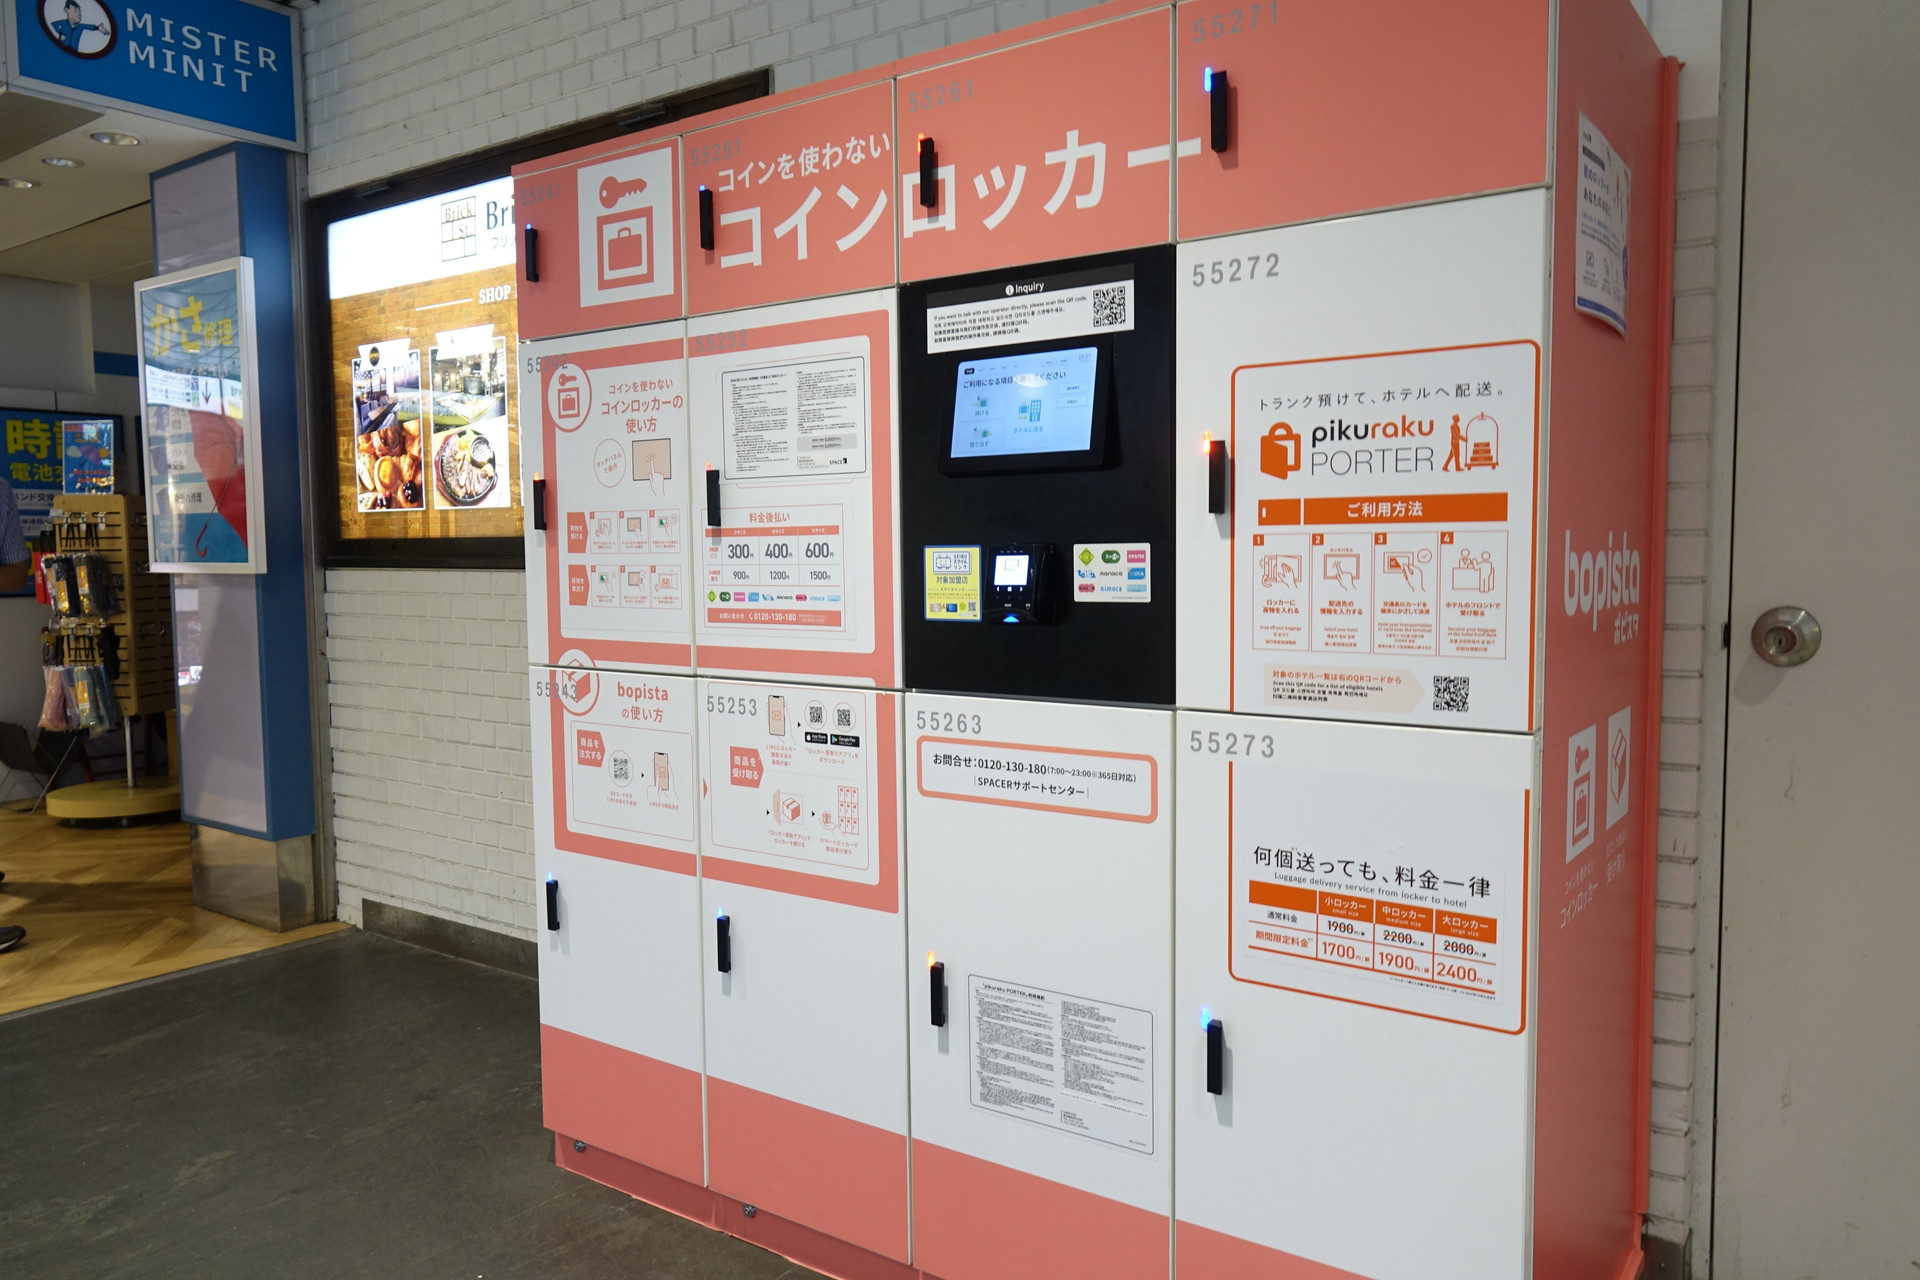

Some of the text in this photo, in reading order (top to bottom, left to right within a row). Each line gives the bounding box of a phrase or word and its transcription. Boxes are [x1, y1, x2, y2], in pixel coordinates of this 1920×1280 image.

[1192, 2, 1279, 43] 55271
[126, 8, 278, 73] MISTER
[129, 41, 253, 93] MINIT
[908, 78, 973, 113] 55261
[691, 138, 743, 168] 55251
[719, 132, 891, 193] コインを使わない
[520, 182, 562, 206] 55241
[720, 129, 1201, 269] コインロッカー
[1193, 253, 1279, 287] 55272
[479, 284, 507, 304] SHOP
[1015, 281, 1045, 296] Inquiry
[696, 329, 747, 353] 55252
[527, 353, 569, 374] 55242
[609, 379, 673, 395] コインを使わない
[1260, 380, 1503, 411] トランク預けて、ホテルへ配送。
[601, 395, 684, 415] コインロッカーの
[626, 416, 658, 434] 使い方
[1312, 414, 1435, 448] pikuraku
[1312, 447, 1435, 476] PORTER
[748, 511, 791, 524] 料金後払い
[1347, 500, 1424, 519] ご利用方法
[1564, 529, 1640, 632] bopista
[1263, 607, 1300, 615] 荷物を入れる
[1320, 608, 1363, 616] 情報を入力する
[1328, 600, 1354, 608] 配送先の
[1446, 602, 1501, 610] ホテルのフロントで
[1460, 609, 1486, 617] 受け取る
[753, 612, 797, 622] 0120-130-180
[1273, 670, 1402, 685] 対象のホテル一覧は右のQRコードから
[537, 681, 577, 700] 55243
[617, 682, 669, 703] bopista
[622, 706, 664, 723] の使い方
[707, 695, 757, 716] 55253
[917, 711, 982, 734] 55263
[580, 737, 600, 748] 商品を
[1190, 730, 1274, 758] 55273
[579, 749, 602, 760] 注文する
[733, 756, 757, 767] 商品を
[733, 768, 759, 780] 受け取る
[978, 777, 1085, 797] SPACERサポートセンター
[1253, 845, 1491, 899] 何個送っても、料金一律
[1274, 872, 1468, 909] Luggage delivery service from locker to hotel
[1325, 896, 1367, 911] 小ロッカー
[1382, 904, 1426, 920] 中ロッカー
[1266, 910, 1298, 924] 通常料金
[1442, 915, 1489, 931] 大ロッカー
[1255, 929, 1309, 949] 期間限定料金
